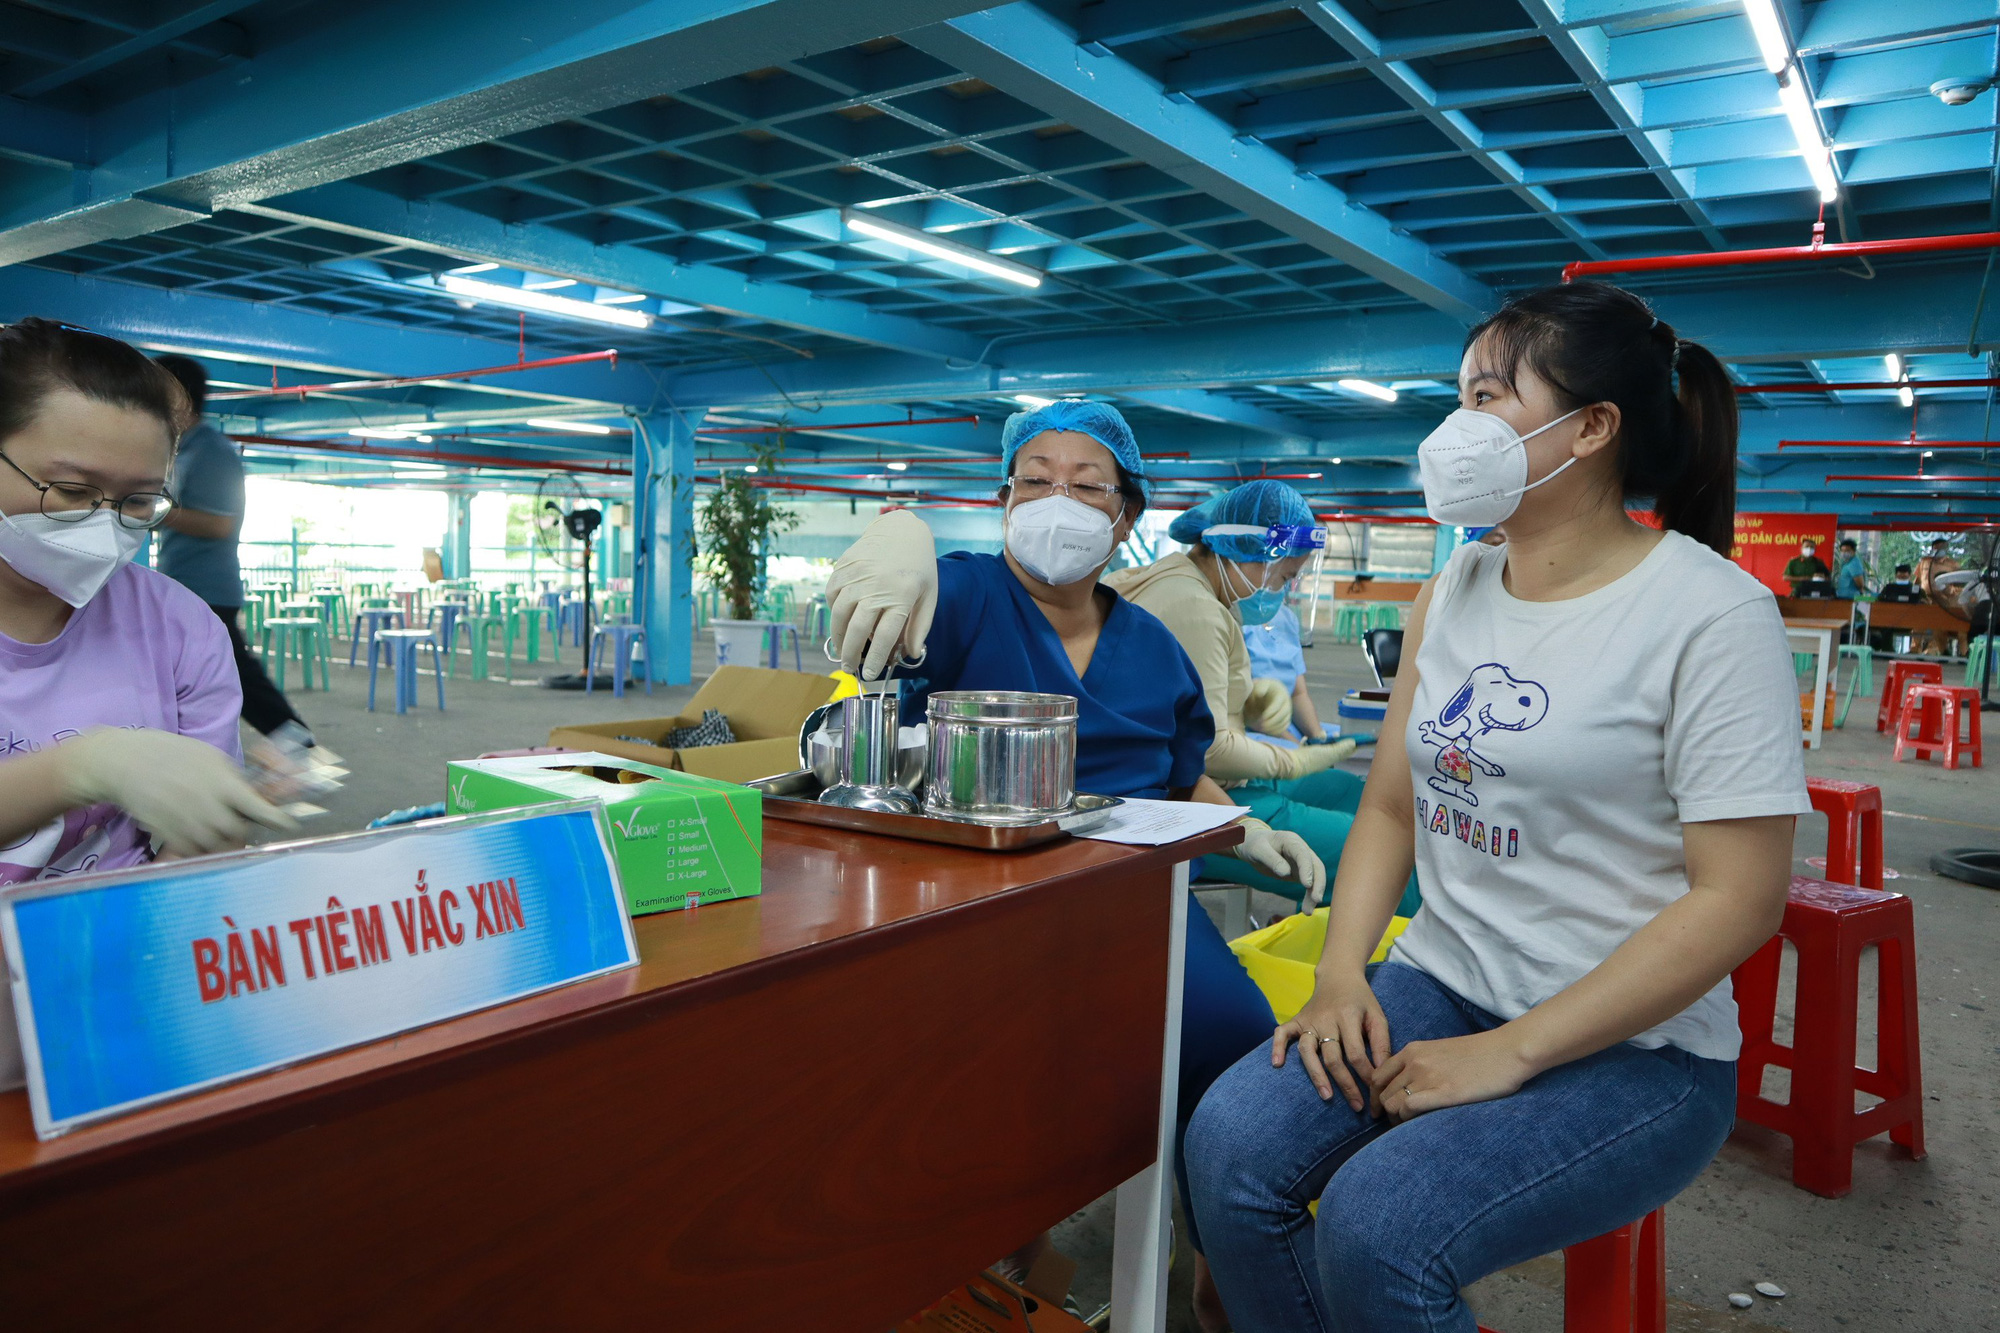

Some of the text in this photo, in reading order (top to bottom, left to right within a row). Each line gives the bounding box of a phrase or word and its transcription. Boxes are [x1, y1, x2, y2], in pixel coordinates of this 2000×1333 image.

[1458, 477, 1474, 486] N95
[678, 817, 708, 827] X-Small
[1416, 796, 1520, 858] HAWAII
[678, 830, 700, 841] Small
[678, 842, 708, 854] Medium
[678, 856, 699, 868] Large
[677, 868, 707, 881] X-Large
[635, 891, 685, 908] Examination
[707, 887, 732, 898] Gloves
[190, 868, 526, 1004] BÀN TIÊM VẮC XIN
